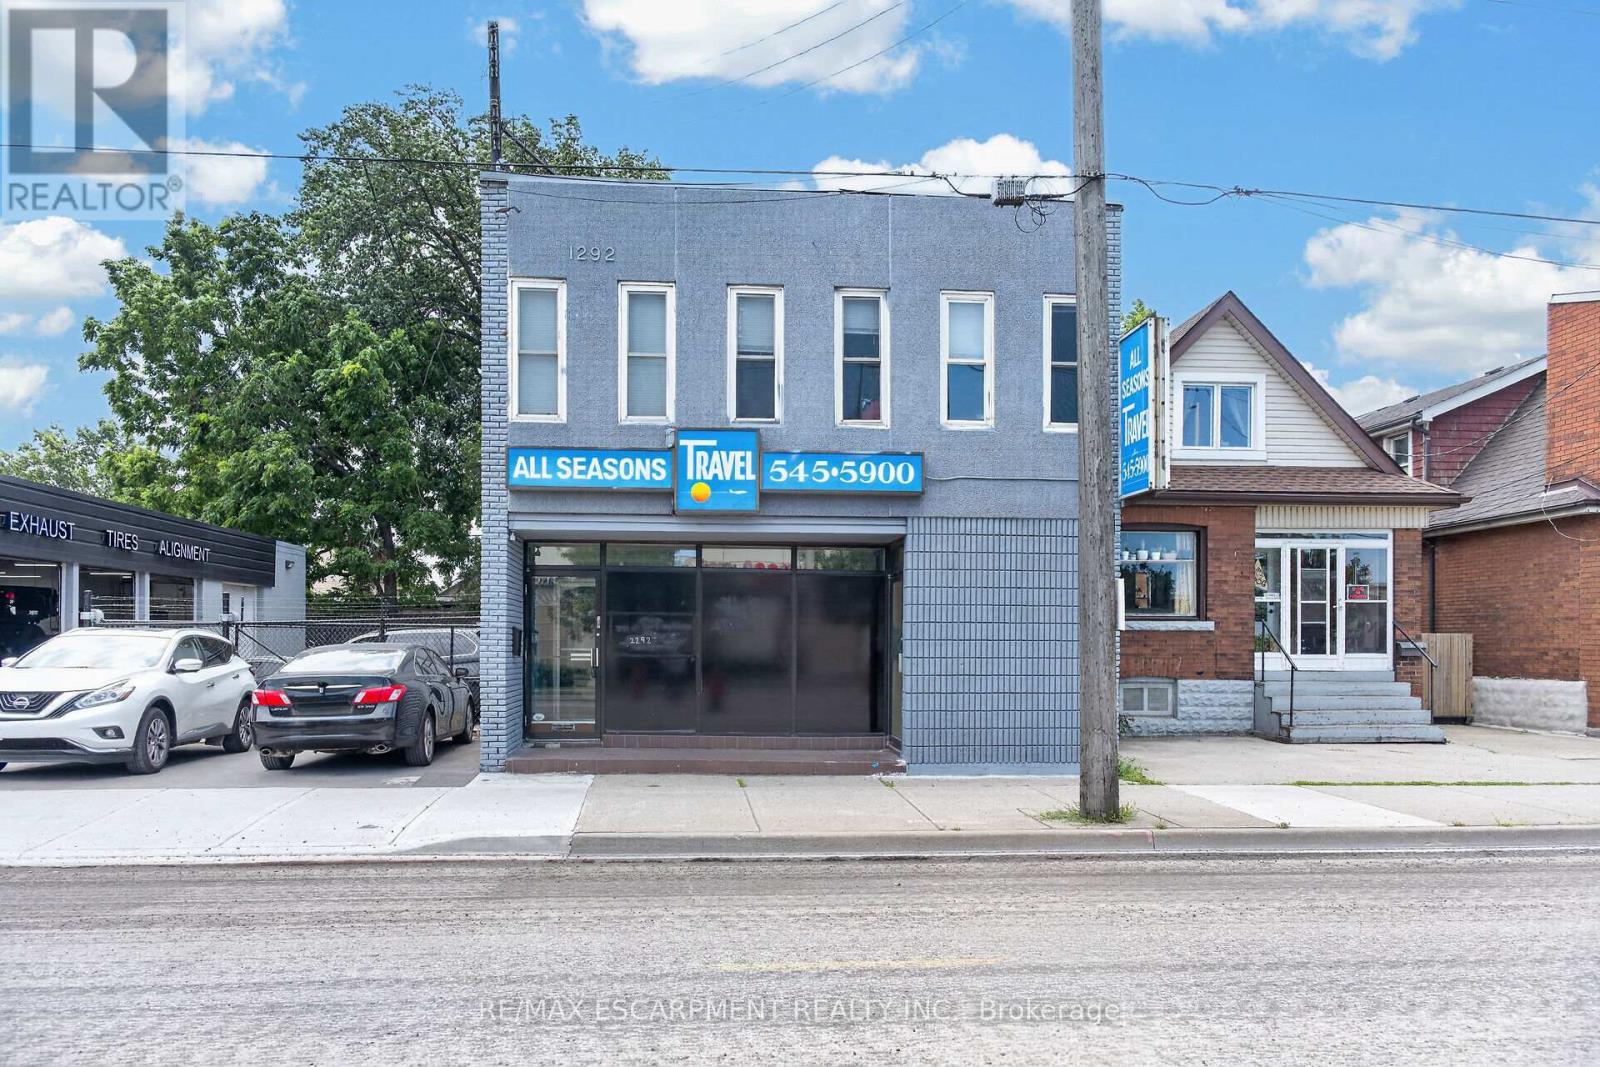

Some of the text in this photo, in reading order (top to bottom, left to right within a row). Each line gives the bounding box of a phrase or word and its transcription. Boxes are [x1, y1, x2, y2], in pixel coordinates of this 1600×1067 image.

[569, 246, 615, 261] 1292
[1130, 346, 1142, 370] ALL
[513, 456, 666, 481] ALL SEASONS
[679, 439, 756, 481] TRAVEL
[10, 511, 75, 541] EXHAUST
[106, 530, 139, 551] TIRES
[159, 540, 211, 562] ALIGNMENT
